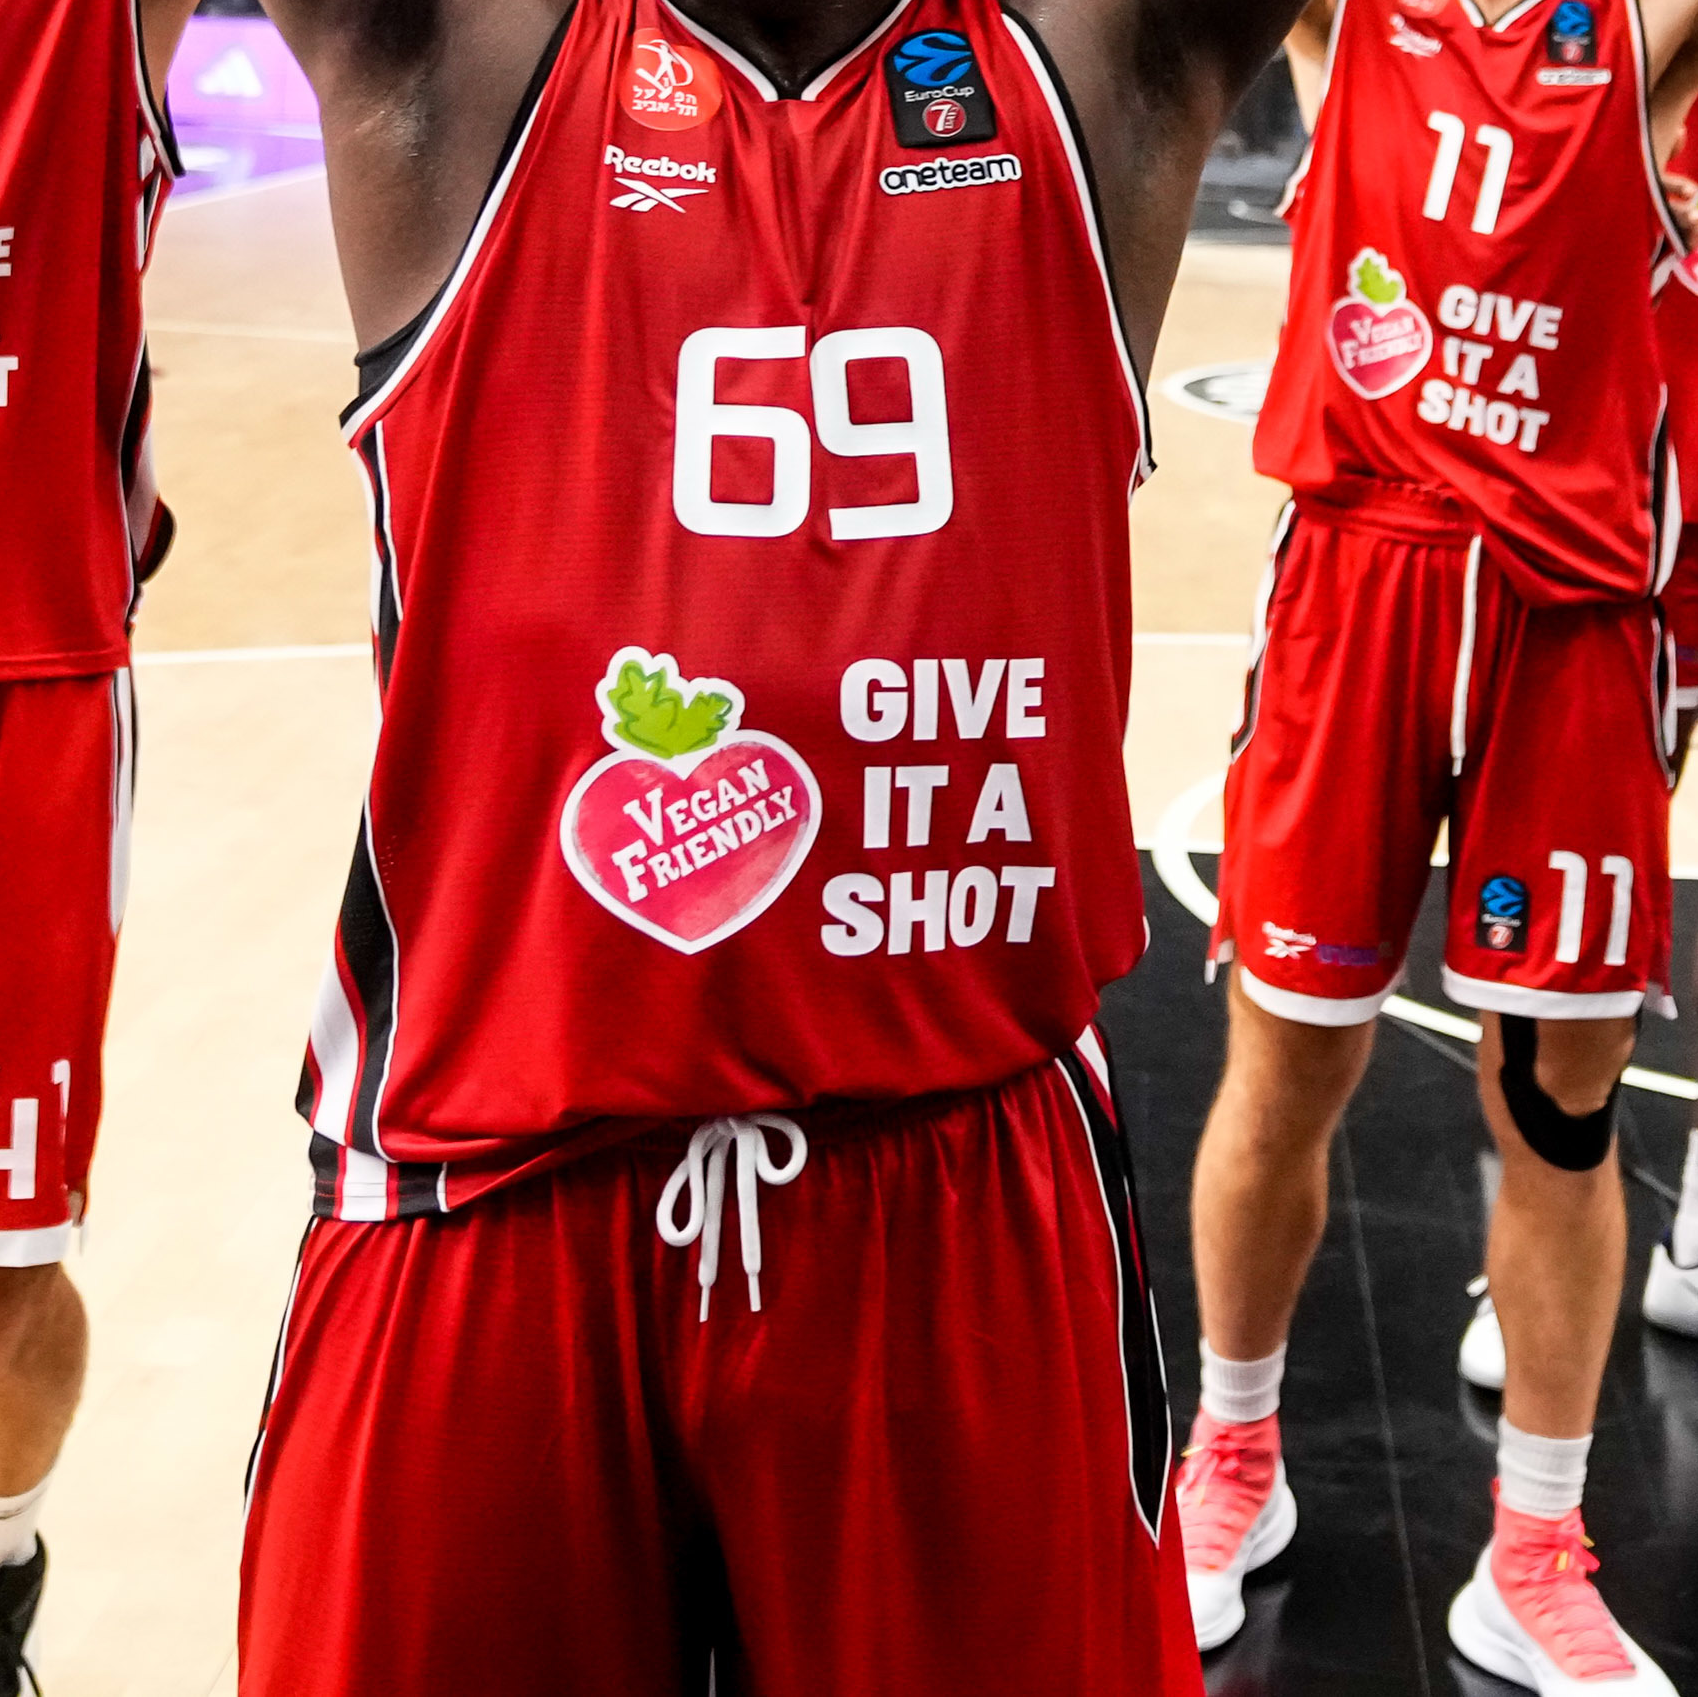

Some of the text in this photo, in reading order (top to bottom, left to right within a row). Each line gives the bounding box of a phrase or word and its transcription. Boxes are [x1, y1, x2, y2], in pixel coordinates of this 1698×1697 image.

[904, 86, 975, 102] EuroCup
[604, 145, 716, 185] Reebok
[883, 158, 1017, 191] oneteam
[1422, 110, 1514, 234] 11
[1438, 284, 1564, 351] GIVE
[1443, 336, 1541, 400] IT A
[671, 325, 955, 541] 69
[1417, 378, 1552, 453] SHOT
[840, 657, 1047, 742] GIVE
[612, 785, 799, 904] FRIENDLY
[623, 758, 771, 847] VEGAN
[862, 764, 1033, 849] IT A
[820, 865, 1056, 957] SHOT
[1548, 850, 1634, 967] 11
